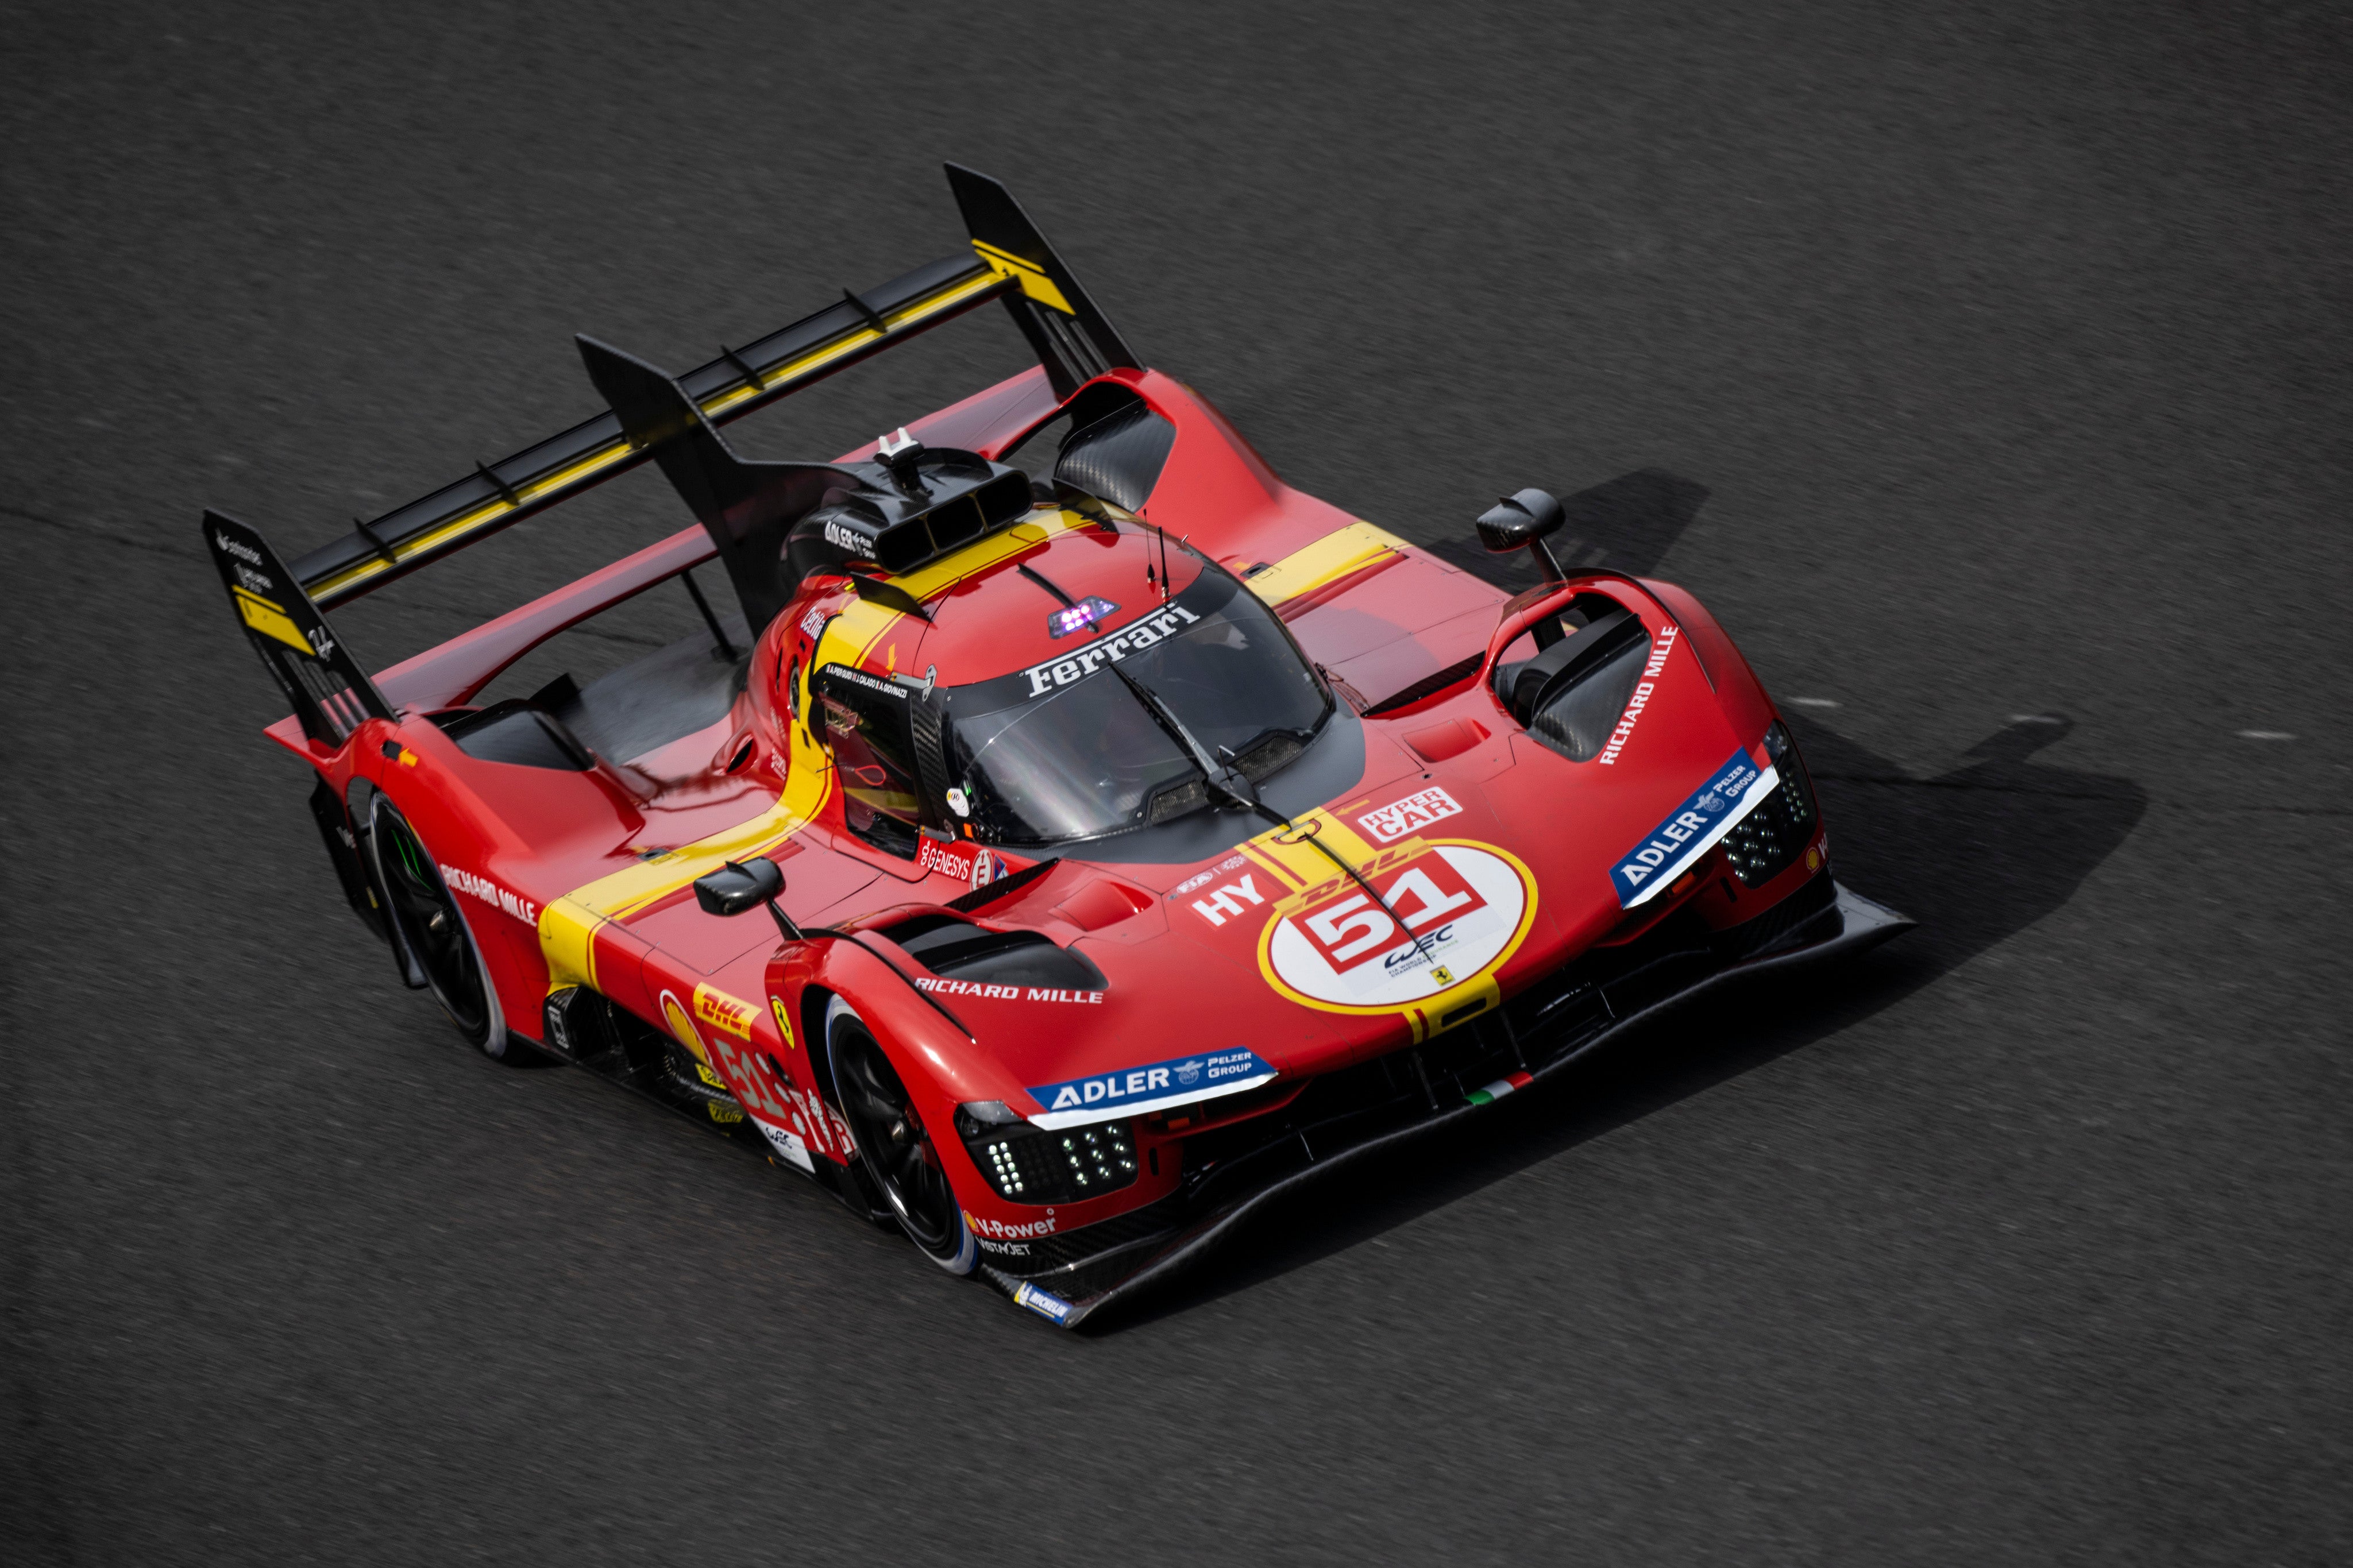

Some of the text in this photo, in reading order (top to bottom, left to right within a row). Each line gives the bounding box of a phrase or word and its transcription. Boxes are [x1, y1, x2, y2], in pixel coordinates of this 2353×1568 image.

[825, 520, 856, 552] ADLER
[1025, 602, 1201, 698] Ferrari
[1599, 626, 1679, 765] RICHARD MILLE
[1712, 765, 1746, 793] PELZER
[1725, 770, 1756, 797] GROUP
[1364, 790, 1441, 826] HYPER
[1375, 799, 1455, 837] CAR
[927, 848, 970, 880] GENESYS
[1620, 811, 1708, 887] ADLER
[439, 863, 538, 928] RICHARD MILLE
[1191, 874, 1265, 926] HY
[1305, 867, 1473, 963] 51
[1384, 924, 1453, 969] WEC
[915, 978, 1104, 1004] RICHARD MILLE
[703, 992, 746, 1030] DHL
[713, 1037, 786, 1119] 51
[1208, 1052, 1252, 1067] PELZER
[1208, 1063, 1252, 1079] GROUP
[1051, 1067, 1170, 1110] ADLER
[975, 1216, 1056, 1238] V-Power
[1029, 1291, 1069, 1318] MICHELIN
